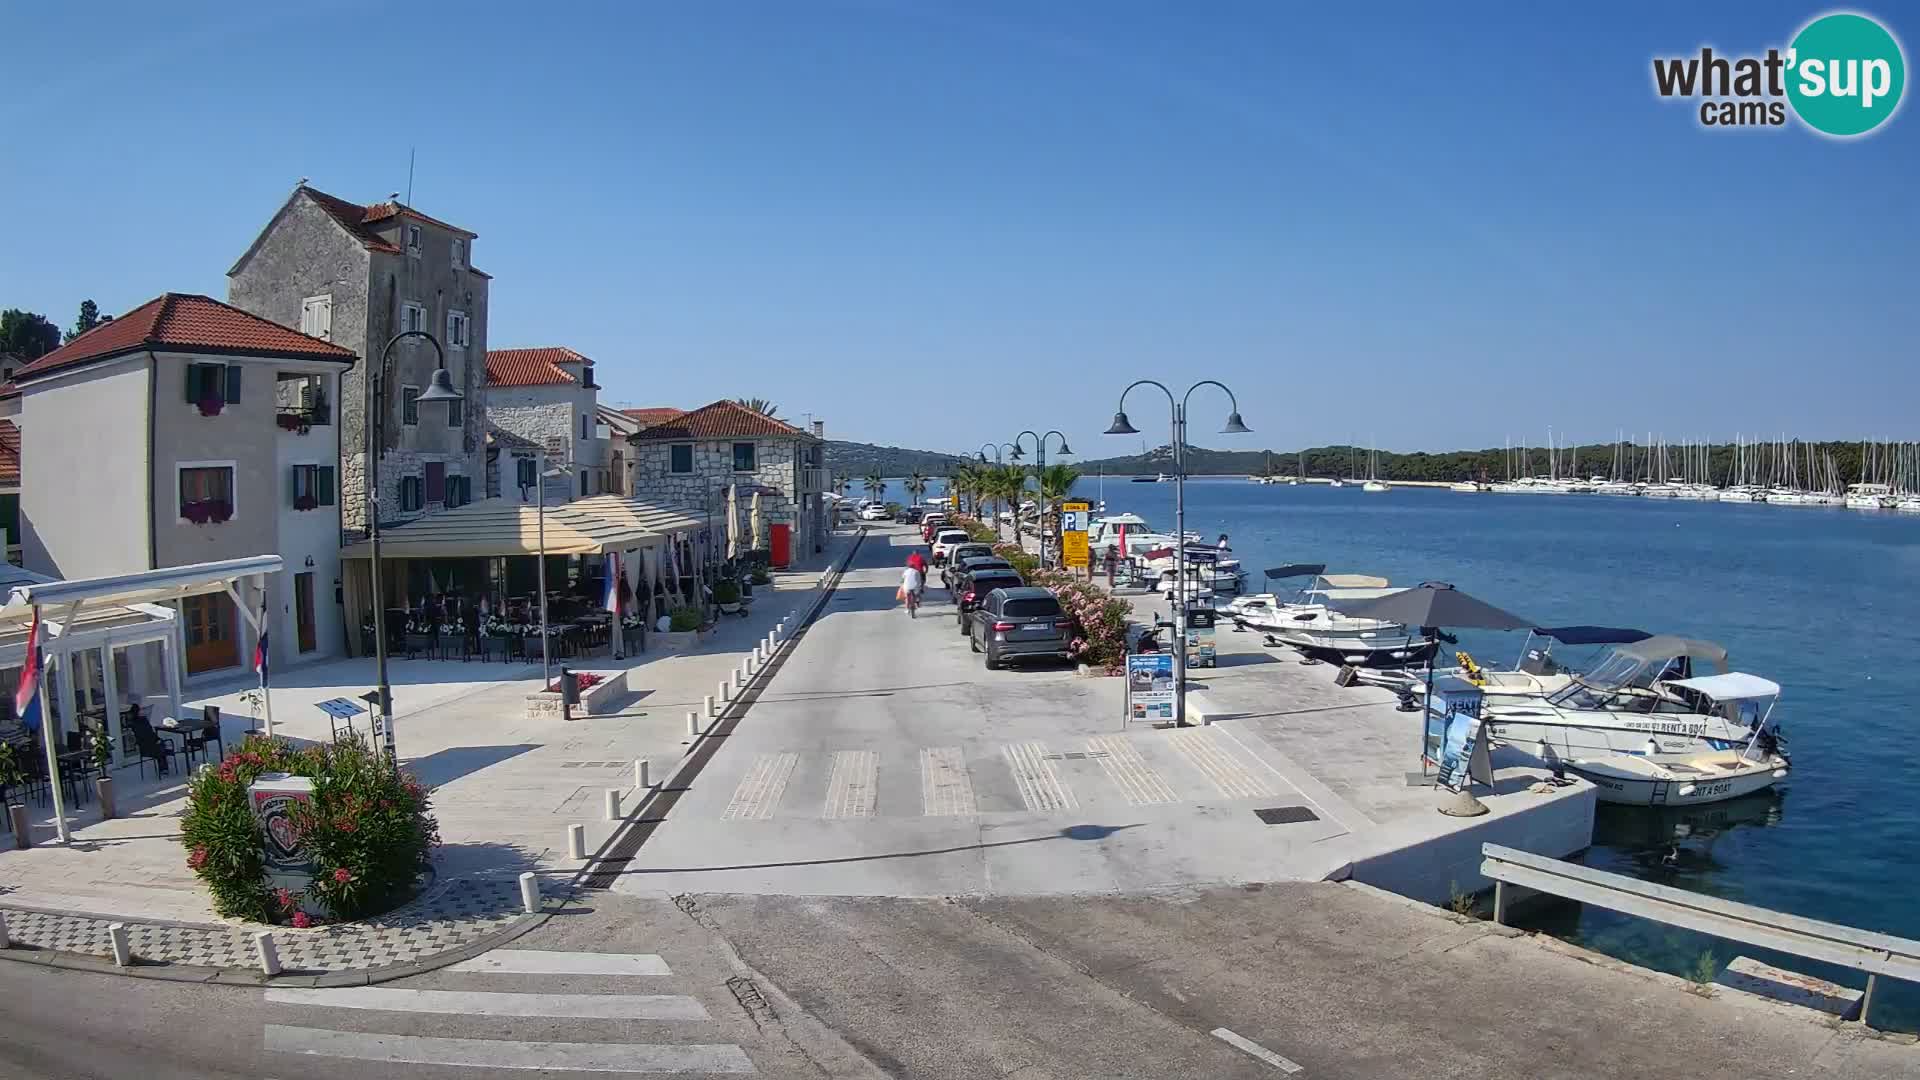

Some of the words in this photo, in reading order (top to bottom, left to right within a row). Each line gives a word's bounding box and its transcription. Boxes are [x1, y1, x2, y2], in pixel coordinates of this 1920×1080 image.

[1064, 513, 1075, 530] P
[1447, 696, 1479, 709] RENT
[1446, 708, 1454, 719] A
[1661, 723, 1681, 733] RENT
